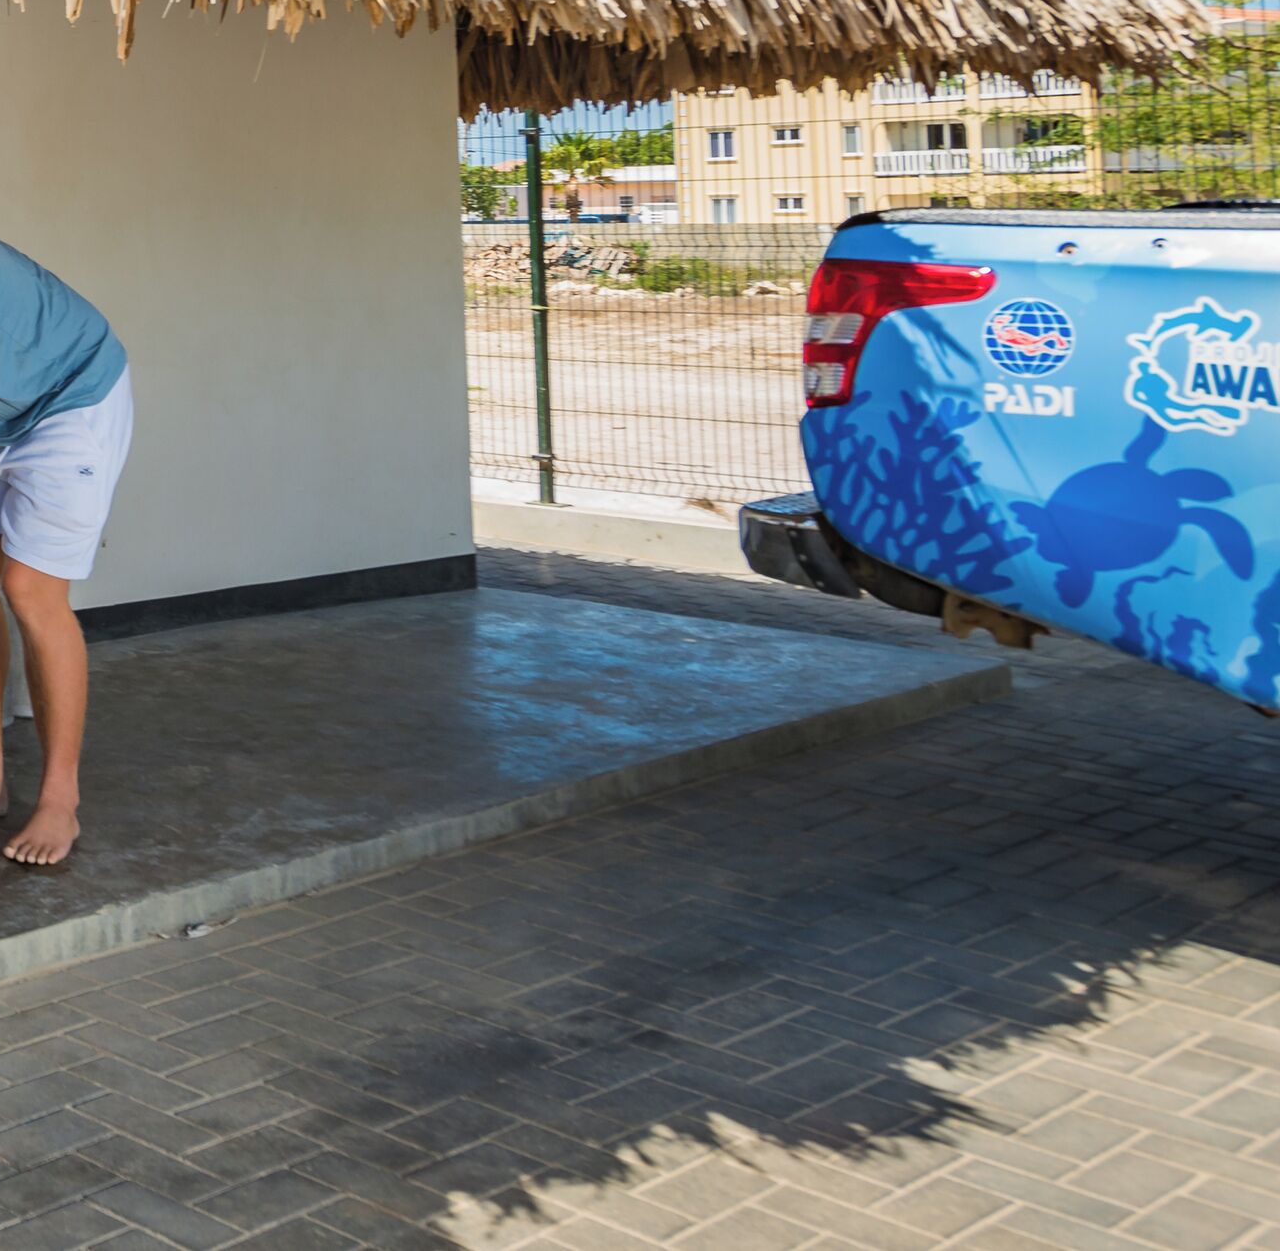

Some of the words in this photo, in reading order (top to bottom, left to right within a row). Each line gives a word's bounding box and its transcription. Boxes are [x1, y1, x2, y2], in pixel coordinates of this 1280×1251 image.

[1195, 342, 1280, 364] PROJ
[984, 382, 1075, 417] PADI
[1192, 362, 1279, 407] AWA
